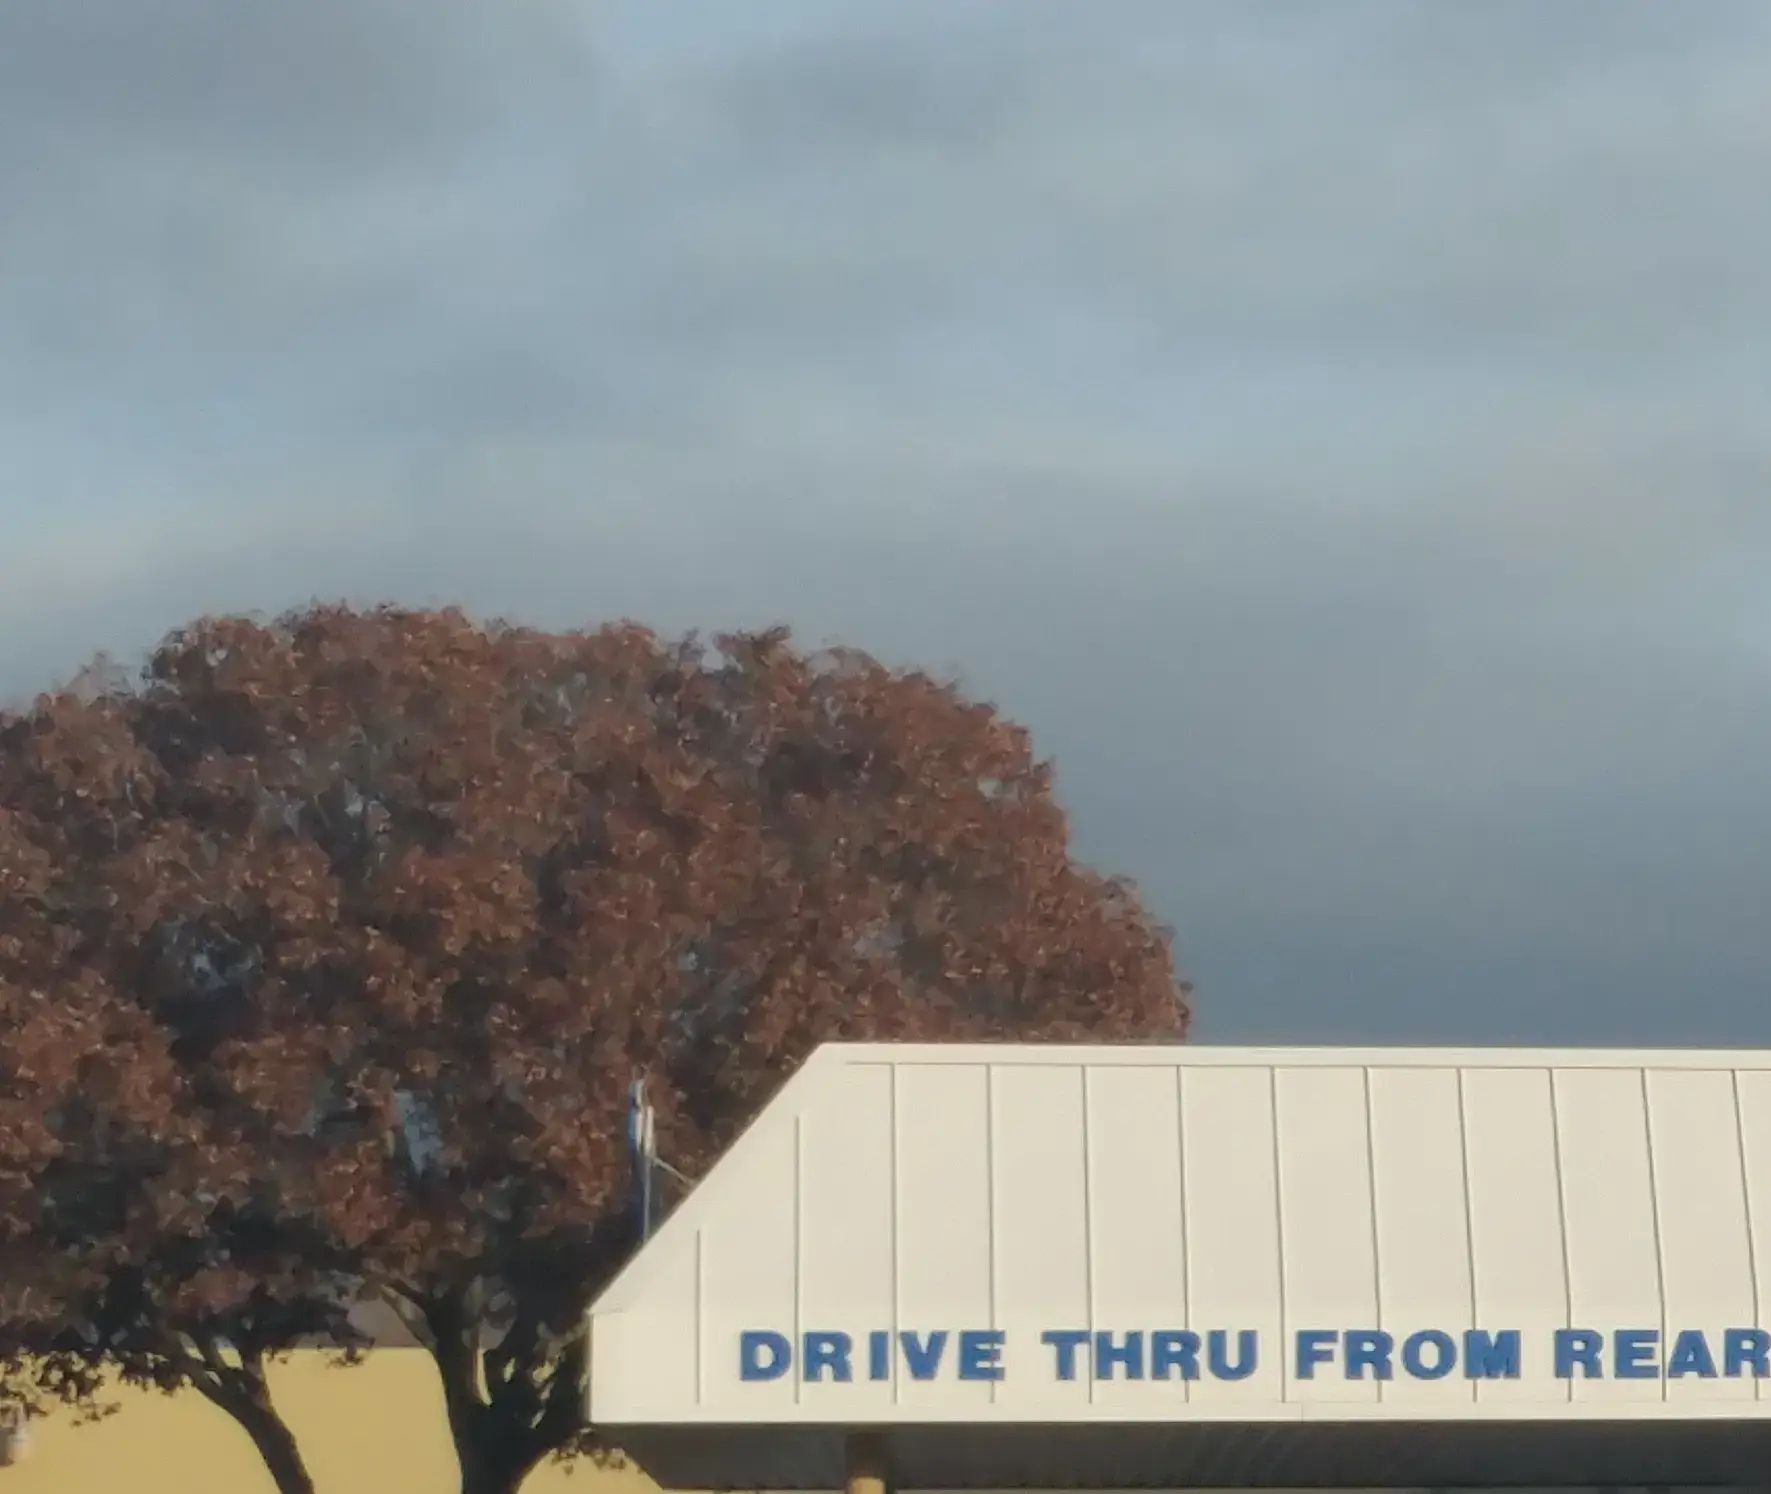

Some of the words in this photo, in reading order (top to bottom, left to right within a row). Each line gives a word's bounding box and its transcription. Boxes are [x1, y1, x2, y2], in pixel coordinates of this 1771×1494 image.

[739, 1329, 1006, 1382] DRIVE
[1041, 1329, 1260, 1382] THRU
[1295, 1329, 1522, 1381] FROM
